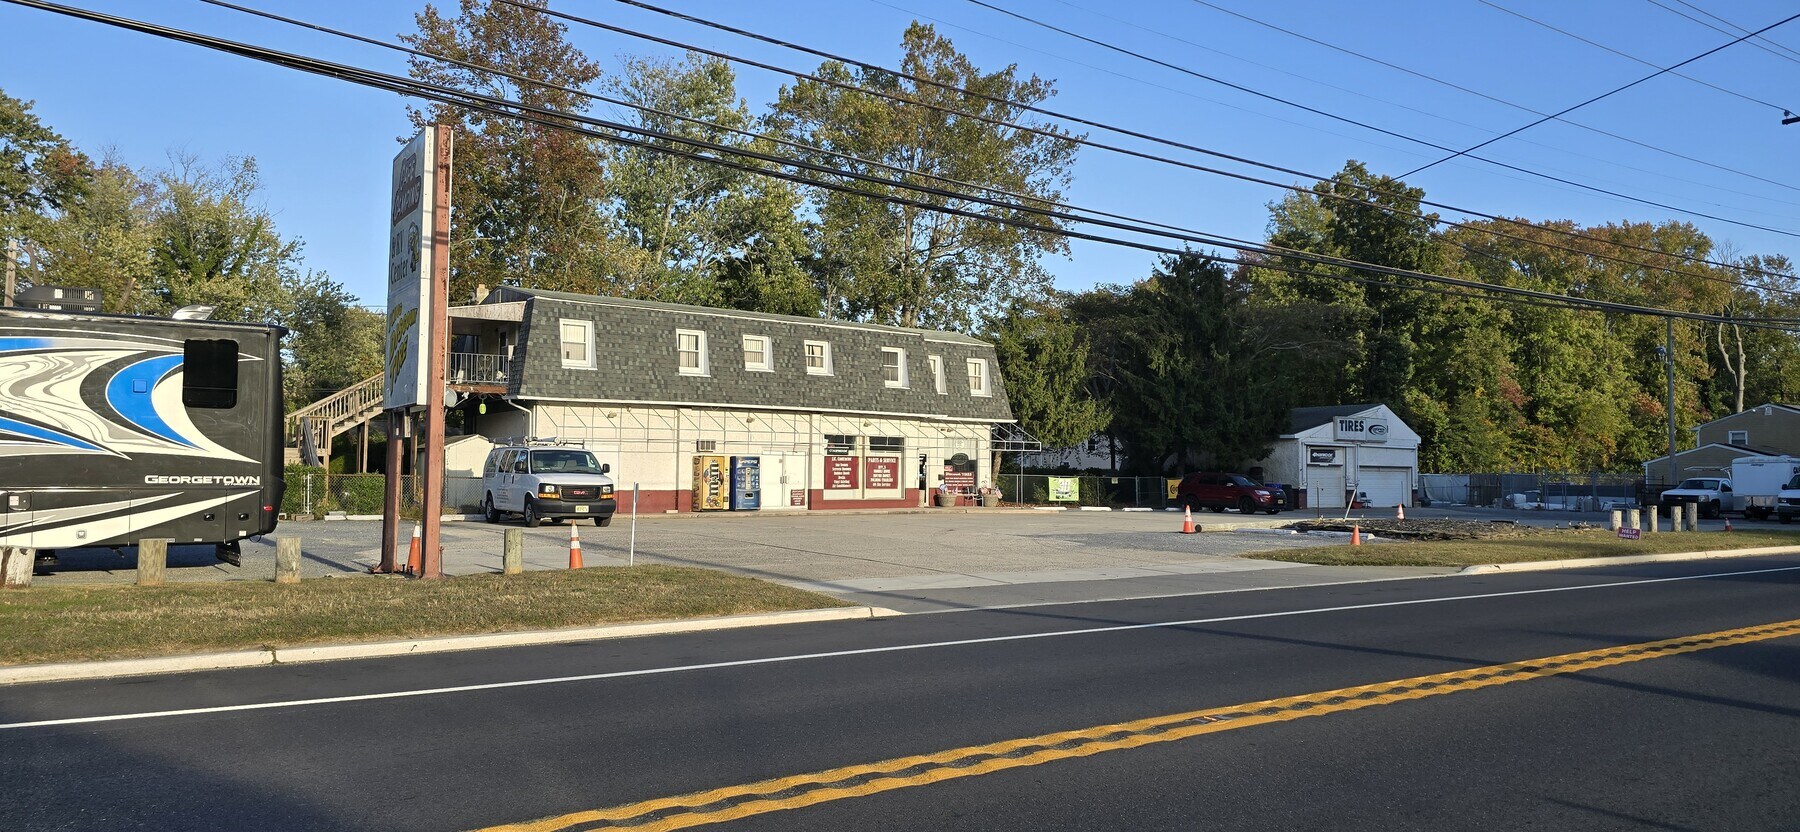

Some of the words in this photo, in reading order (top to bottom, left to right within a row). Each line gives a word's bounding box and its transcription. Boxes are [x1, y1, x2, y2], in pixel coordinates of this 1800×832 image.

[391, 256, 409, 285] Center
[1339, 420, 1364, 432] TIRES
[144, 475, 260, 485] GEORGETOWN
